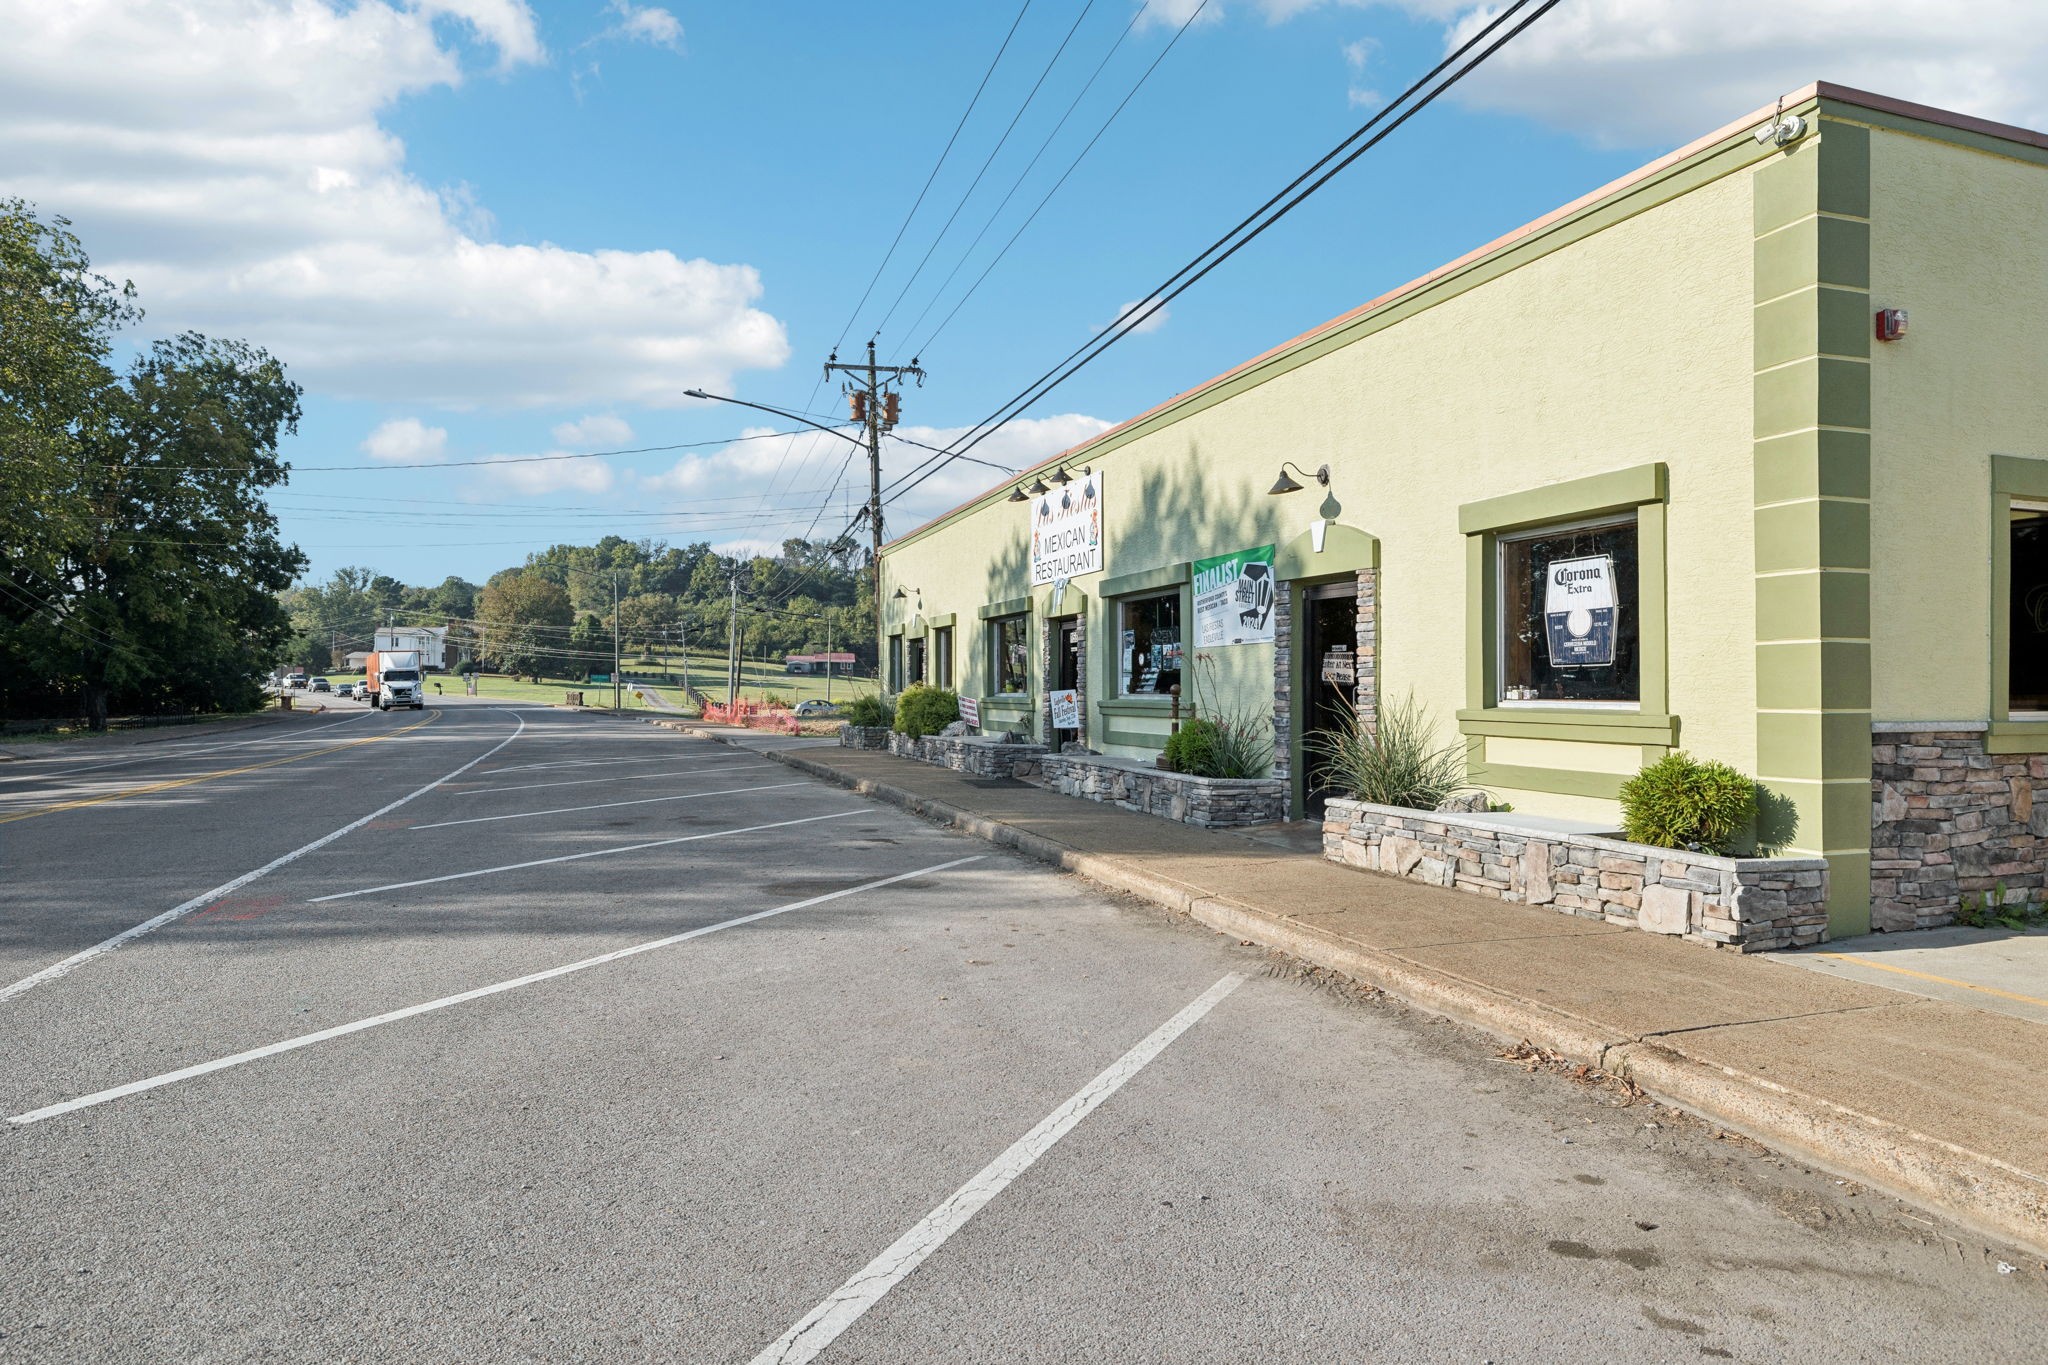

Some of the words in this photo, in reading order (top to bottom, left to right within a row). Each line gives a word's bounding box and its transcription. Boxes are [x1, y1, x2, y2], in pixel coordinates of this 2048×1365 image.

[1044, 525, 1086, 554] MEXICAN
[1035, 548, 1096, 581] RESTAURANT
[1194, 558, 1238, 595] FINALIST
[1238, 579, 1254, 591] MAIN
[1555, 567, 1601, 587] Corona
[1235, 588, 1255, 604] STREET
[1567, 583, 1592, 595] Extra
[1205, 602, 1218, 611] MEXICAN
